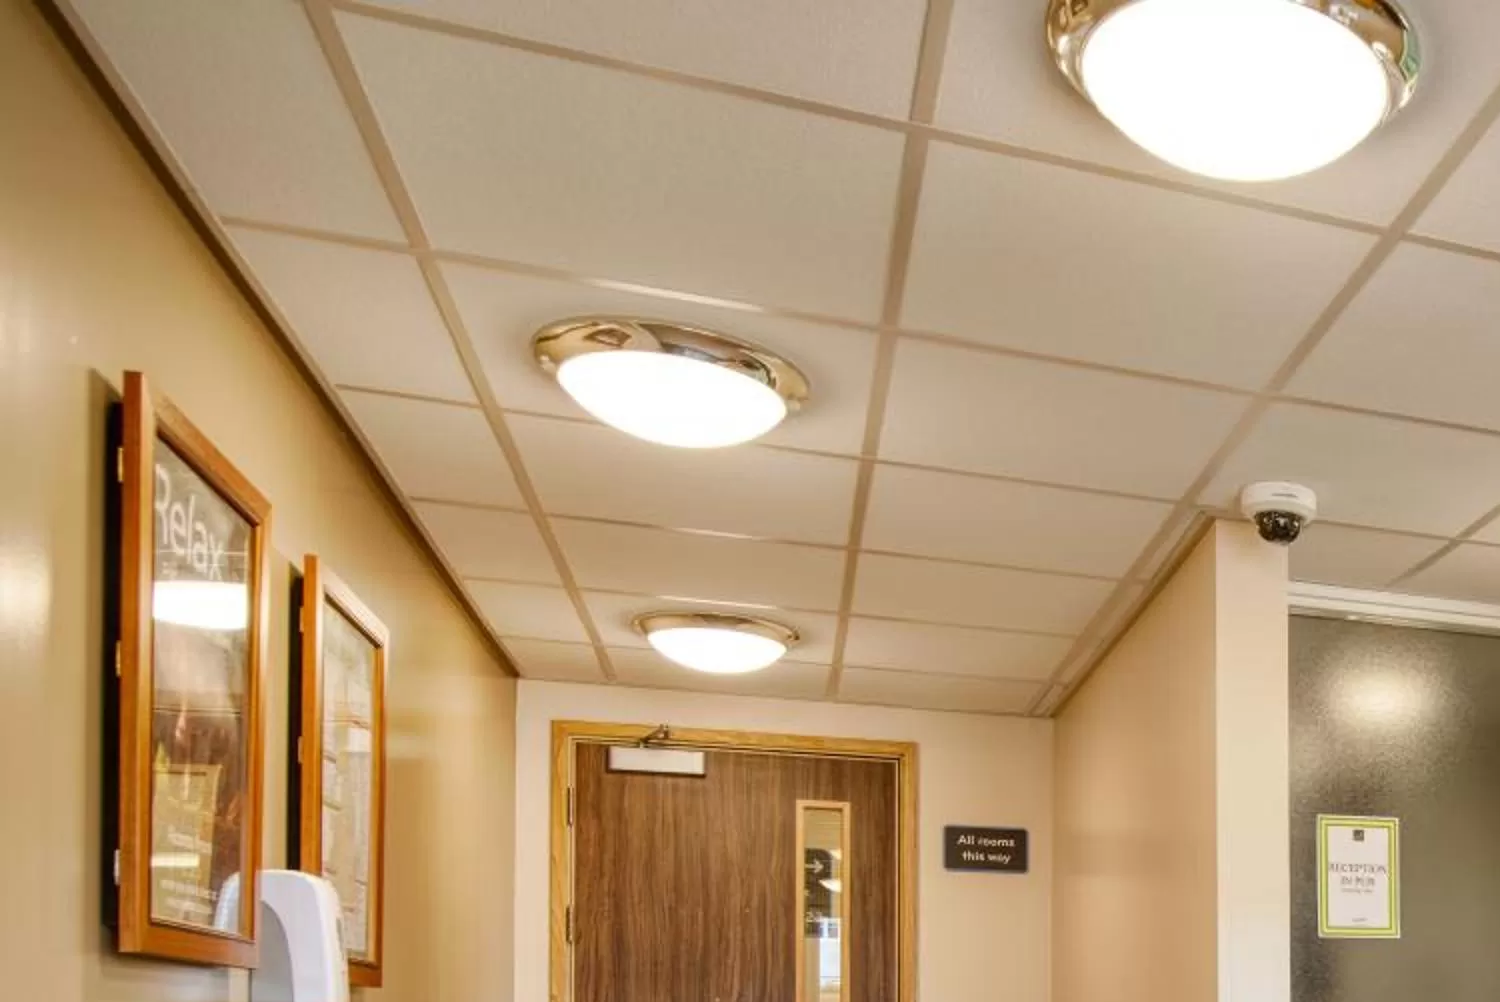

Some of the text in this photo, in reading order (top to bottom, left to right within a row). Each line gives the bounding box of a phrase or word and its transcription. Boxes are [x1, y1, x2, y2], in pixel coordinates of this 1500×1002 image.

[155, 463, 223, 581] Relax
[957, 835, 1016, 847] All rooms
[962, 850, 1012, 865] this way
